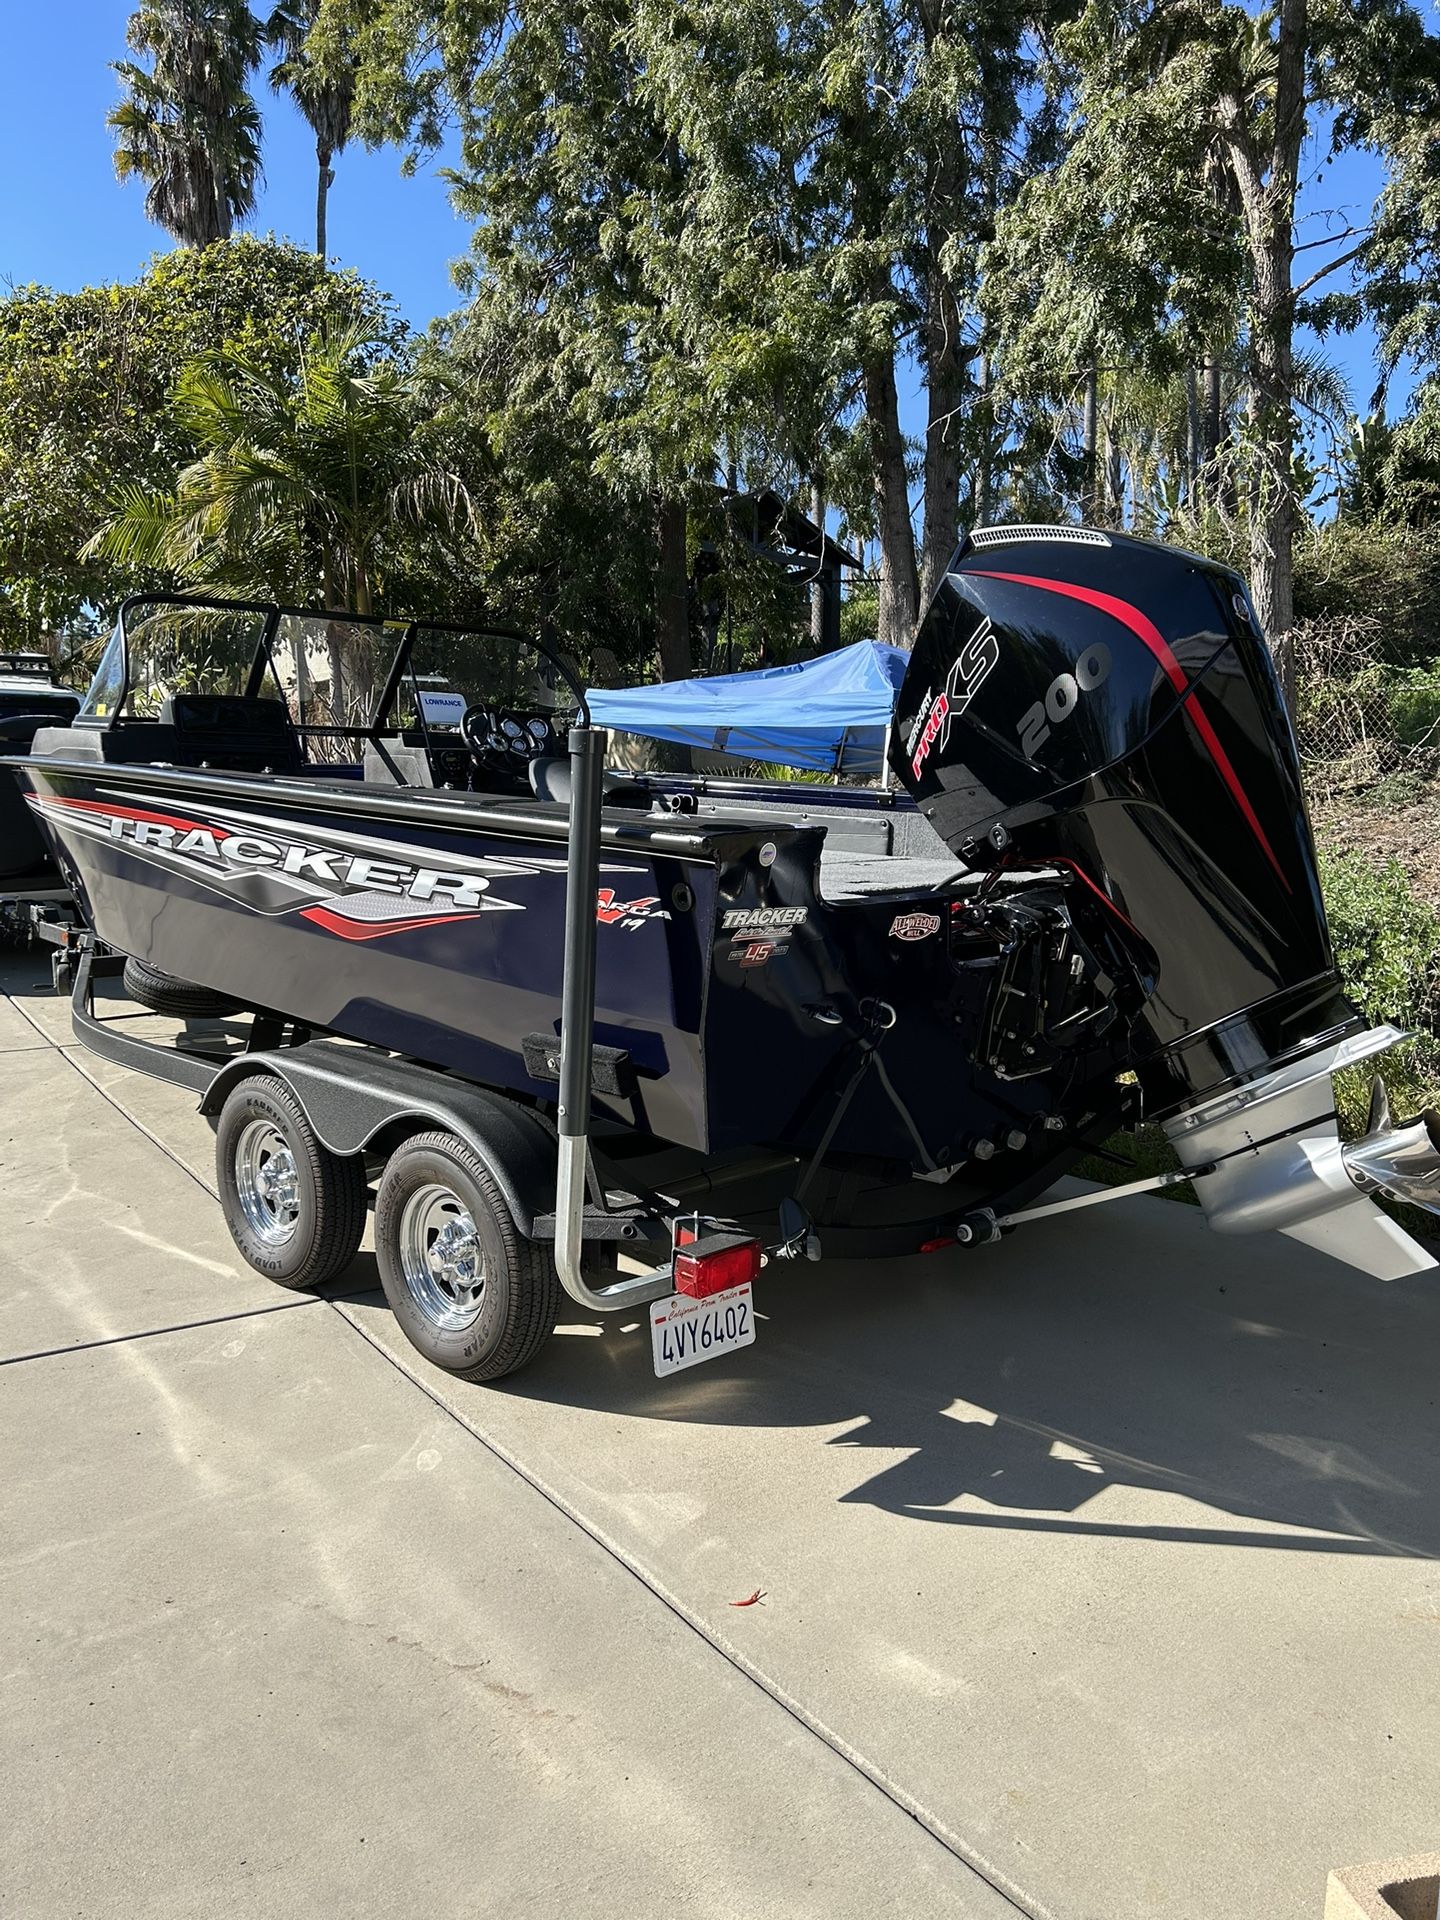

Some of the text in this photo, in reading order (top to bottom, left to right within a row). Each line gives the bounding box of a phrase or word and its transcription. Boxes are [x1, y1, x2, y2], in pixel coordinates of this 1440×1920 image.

[424, 698, 462, 707] LOWRANCE
[906, 685, 933, 757] MERCURY
[1016, 642, 1113, 761] 200
[912, 692, 950, 782] PRO
[103, 815, 490, 908] TRACKER
[620, 918, 646, 932] 19
[722, 907, 808, 928] TRACKER
[745, 945, 772, 961] 45
[662, 1303, 750, 1362] 4VY6402
[668, 1305, 699, 1321] California
